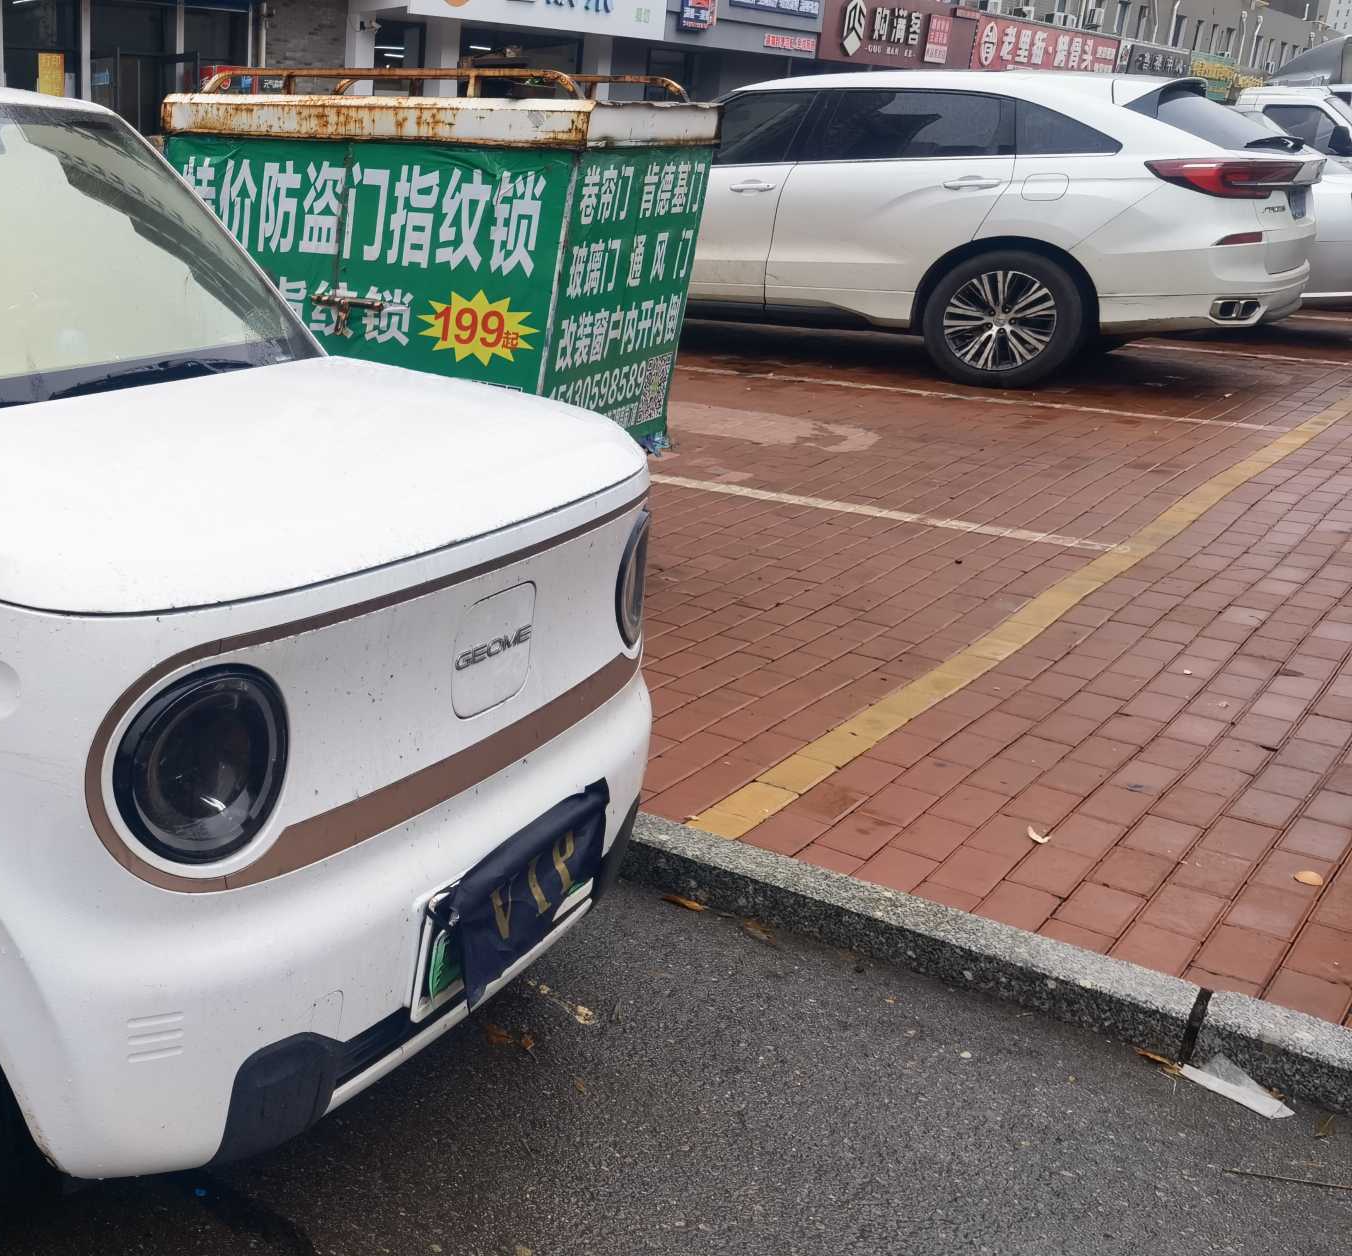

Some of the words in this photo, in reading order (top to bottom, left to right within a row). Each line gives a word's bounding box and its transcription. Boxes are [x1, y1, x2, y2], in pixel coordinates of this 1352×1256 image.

[873, 8, 922, 45] 购满客
[183, 156, 546, 278] 特价防盗门指纹锁
[579, 163, 634, 225] 卷帘门
[639, 161, 705, 219] 肯德基门
[566, 236, 622, 299] 玻璃门
[555, 292, 682, 373] 改装窗户内开内倒
[455, 624, 532, 671] GEOME
[491, 829, 577, 940] VIP
